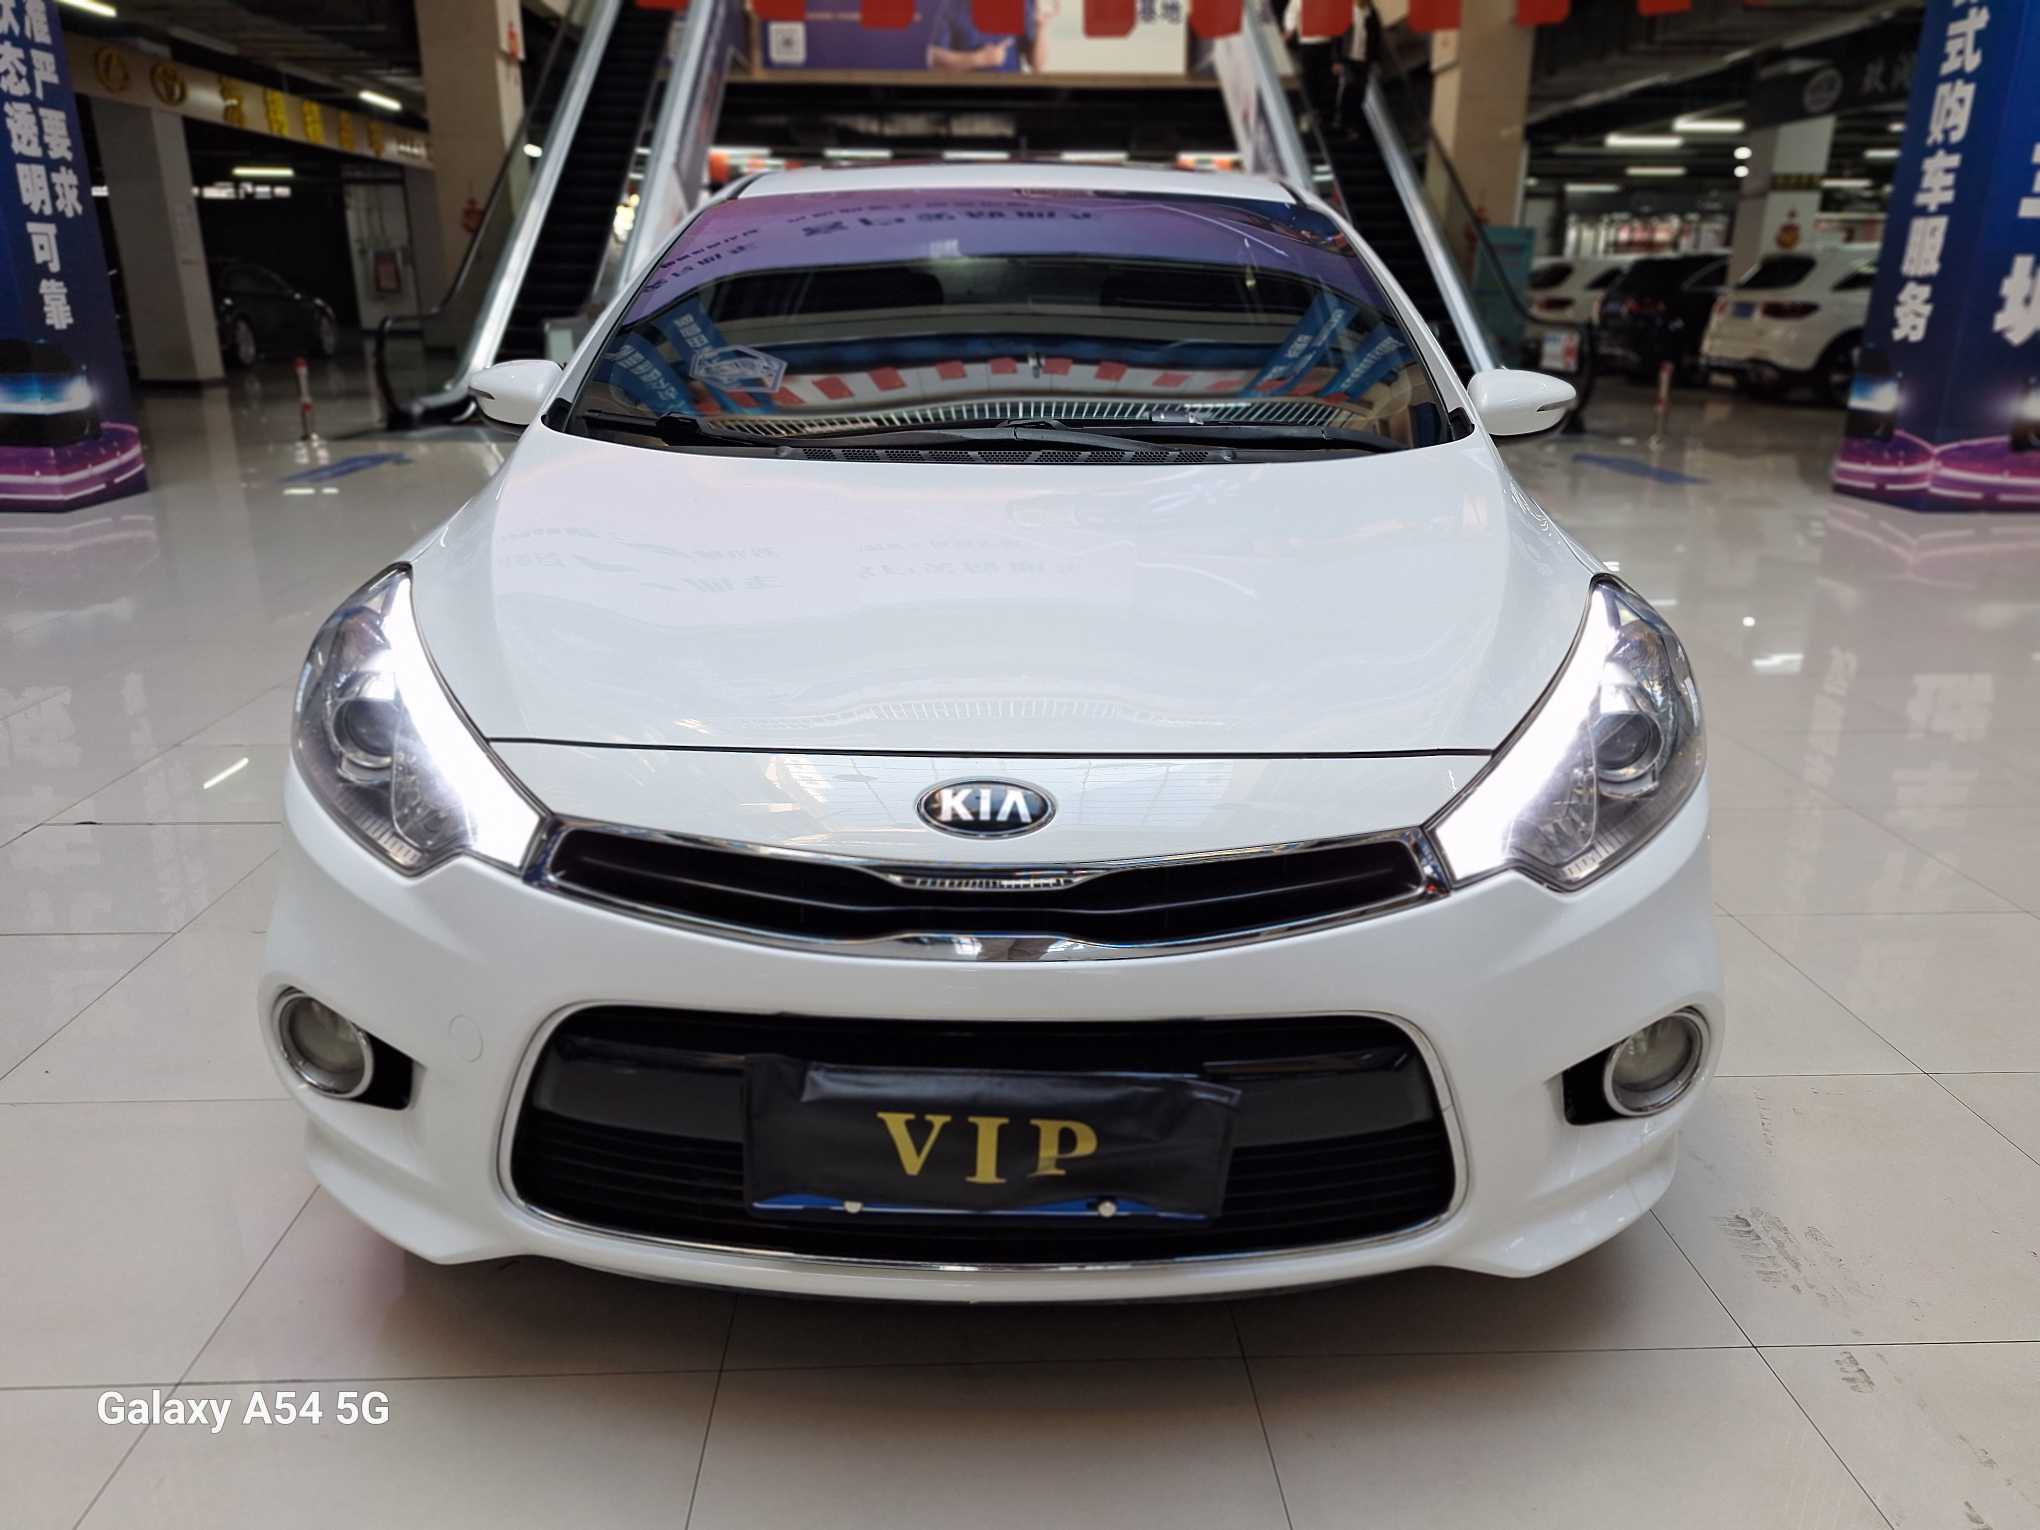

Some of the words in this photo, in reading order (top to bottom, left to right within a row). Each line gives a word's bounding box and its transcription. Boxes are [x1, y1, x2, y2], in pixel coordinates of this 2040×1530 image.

[1892, 0, 1990, 342] 式购车服务
[936, 787, 1032, 823] KIA
[876, 1111, 1099, 1184] VIP
